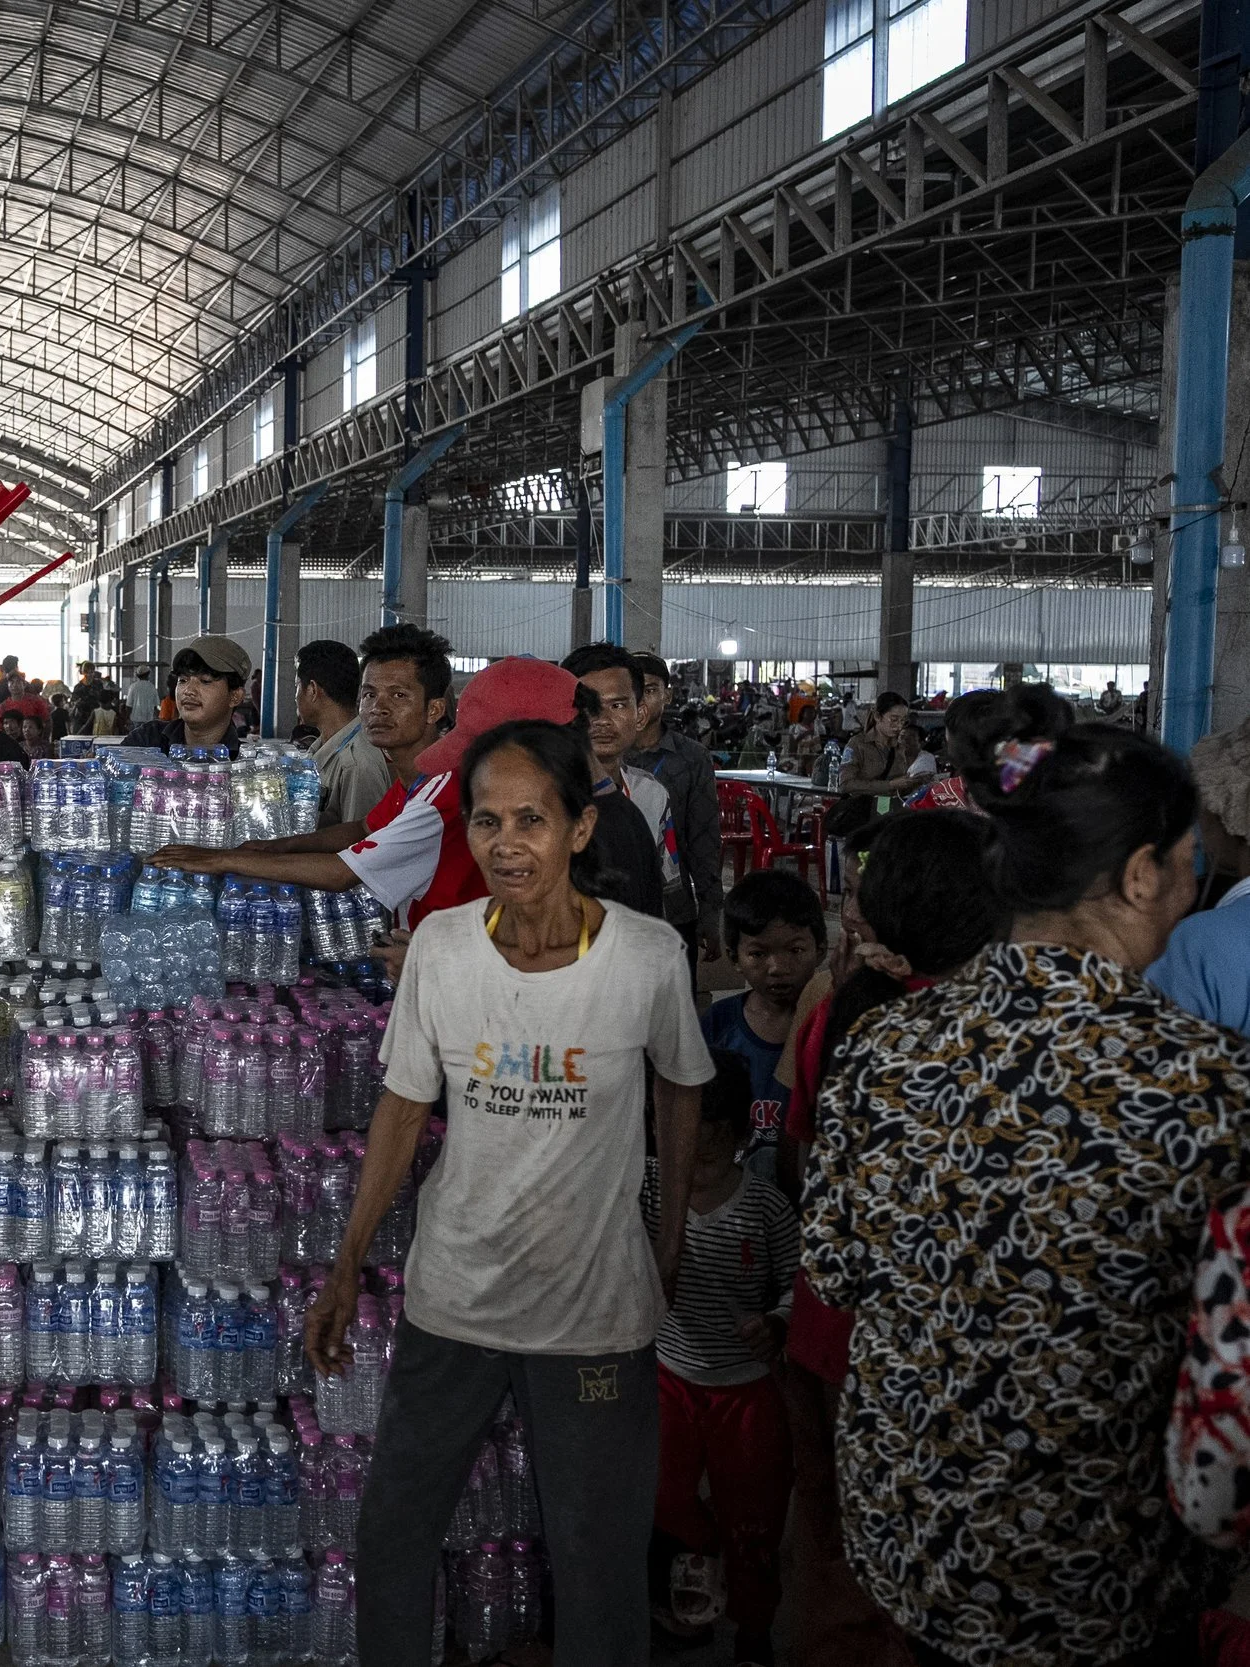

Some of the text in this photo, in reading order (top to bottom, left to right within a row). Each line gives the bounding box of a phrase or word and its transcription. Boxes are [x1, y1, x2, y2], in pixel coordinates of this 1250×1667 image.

[471, 1042, 588, 1083] SMILE
[983, 1011, 1086, 1055] Babe
[463, 1095, 587, 1119] TO SLEEP WITH ME
[490, 1084, 524, 1102] YOU
[536, 1088, 587, 1103] WANT
[934, 1053, 1016, 1127] Babe
[983, 1050, 1071, 1127] Babe
[1075, 1047, 1175, 1124] Babe
[869, 1097, 942, 1163] Babe
[911, 1127, 984, 1204] Babe
[1079, 1111, 1169, 1198] Babe
[853, 1188, 926, 1249] Babe
[956, 1171, 1054, 1215] Babe
[868, 1245, 937, 1318] Babe
[918, 1208, 990, 1284] Babe
[972, 1211, 1050, 1290] Babe
[1050, 1209, 1149, 1286] Babe
[910, 1285, 975, 1358] Babe
[952, 1373, 1036, 1446] Babe
